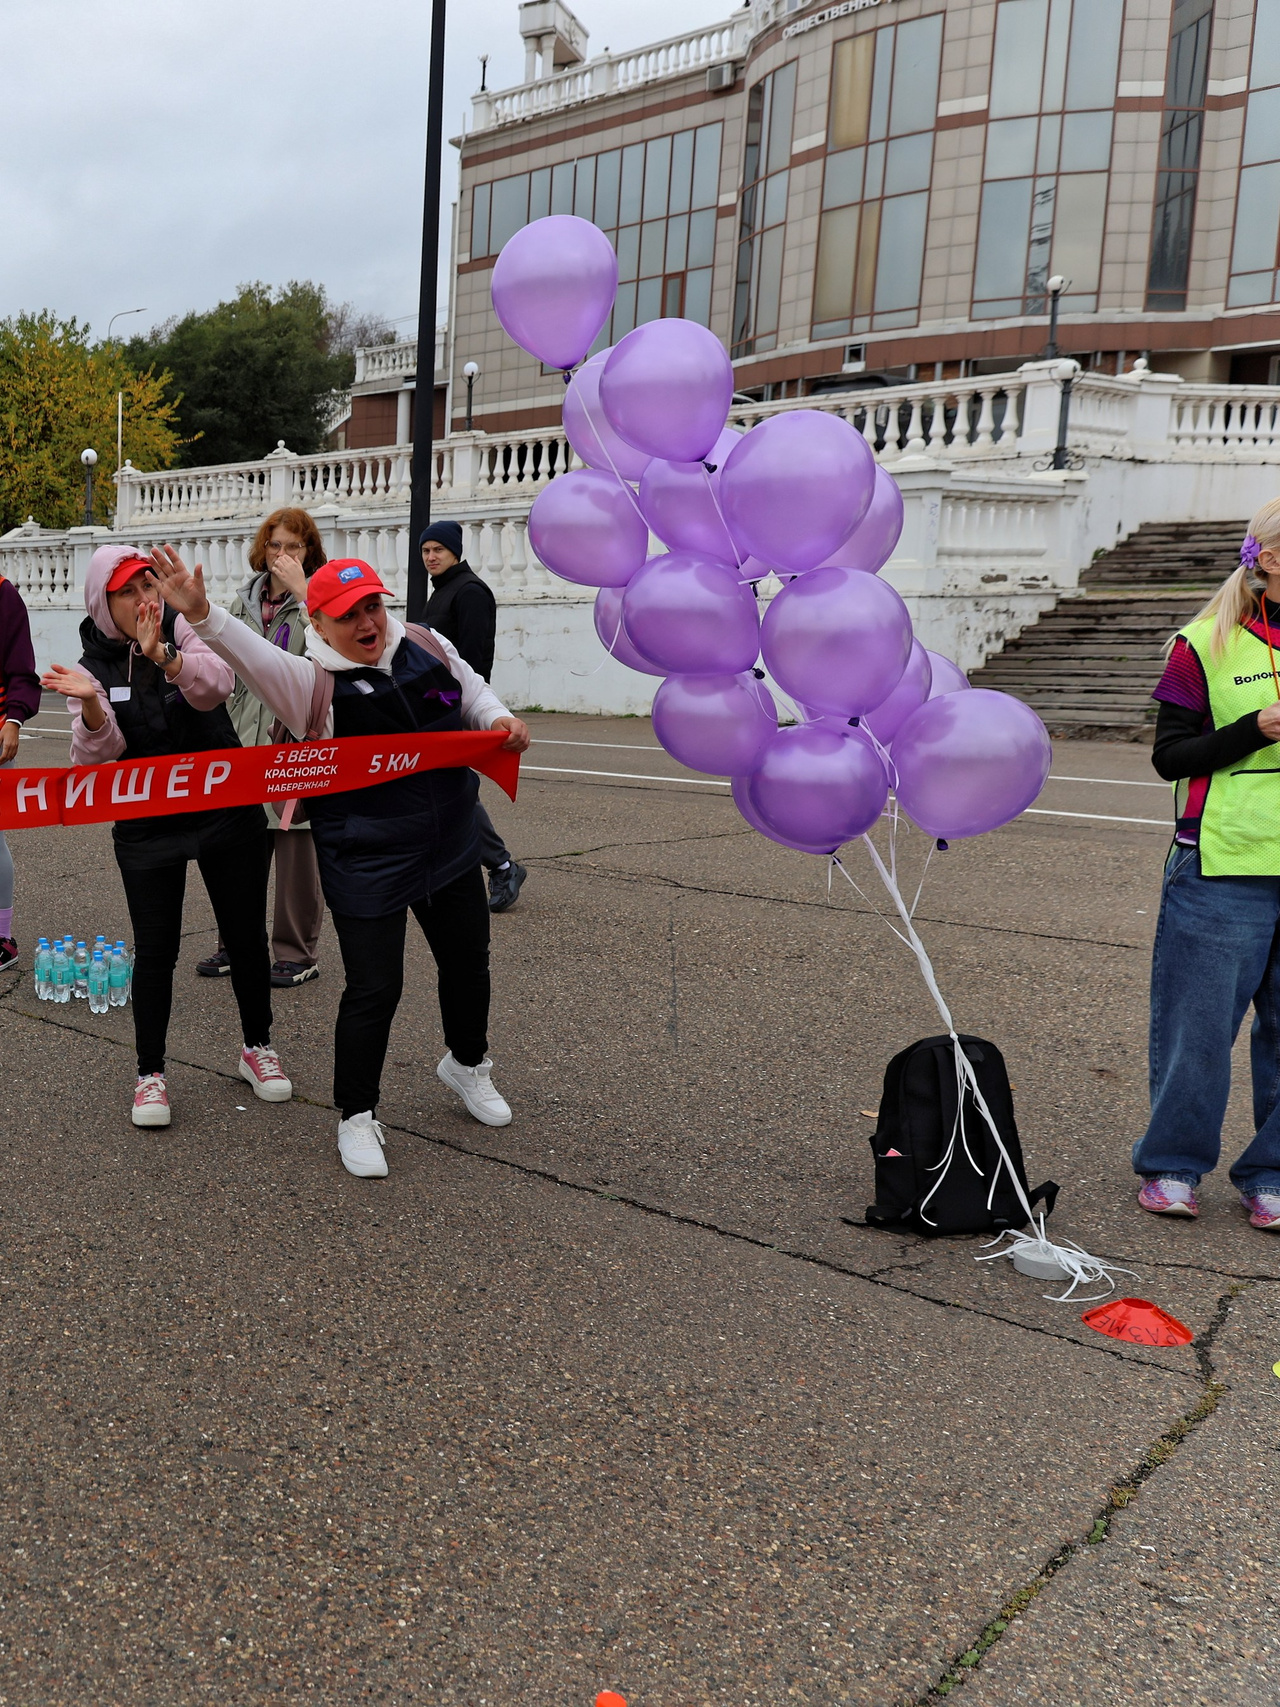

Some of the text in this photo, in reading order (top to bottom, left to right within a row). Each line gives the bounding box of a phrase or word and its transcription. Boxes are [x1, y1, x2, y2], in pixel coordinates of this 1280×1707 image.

[273, 746, 338, 764] 5 ВЁРСТ
[368, 752, 421, 774] 5 КМ
[264, 764, 338, 779] КРАСНОЯРСК
[267, 780, 331, 793] НАБЕРЕЖНАЯ
